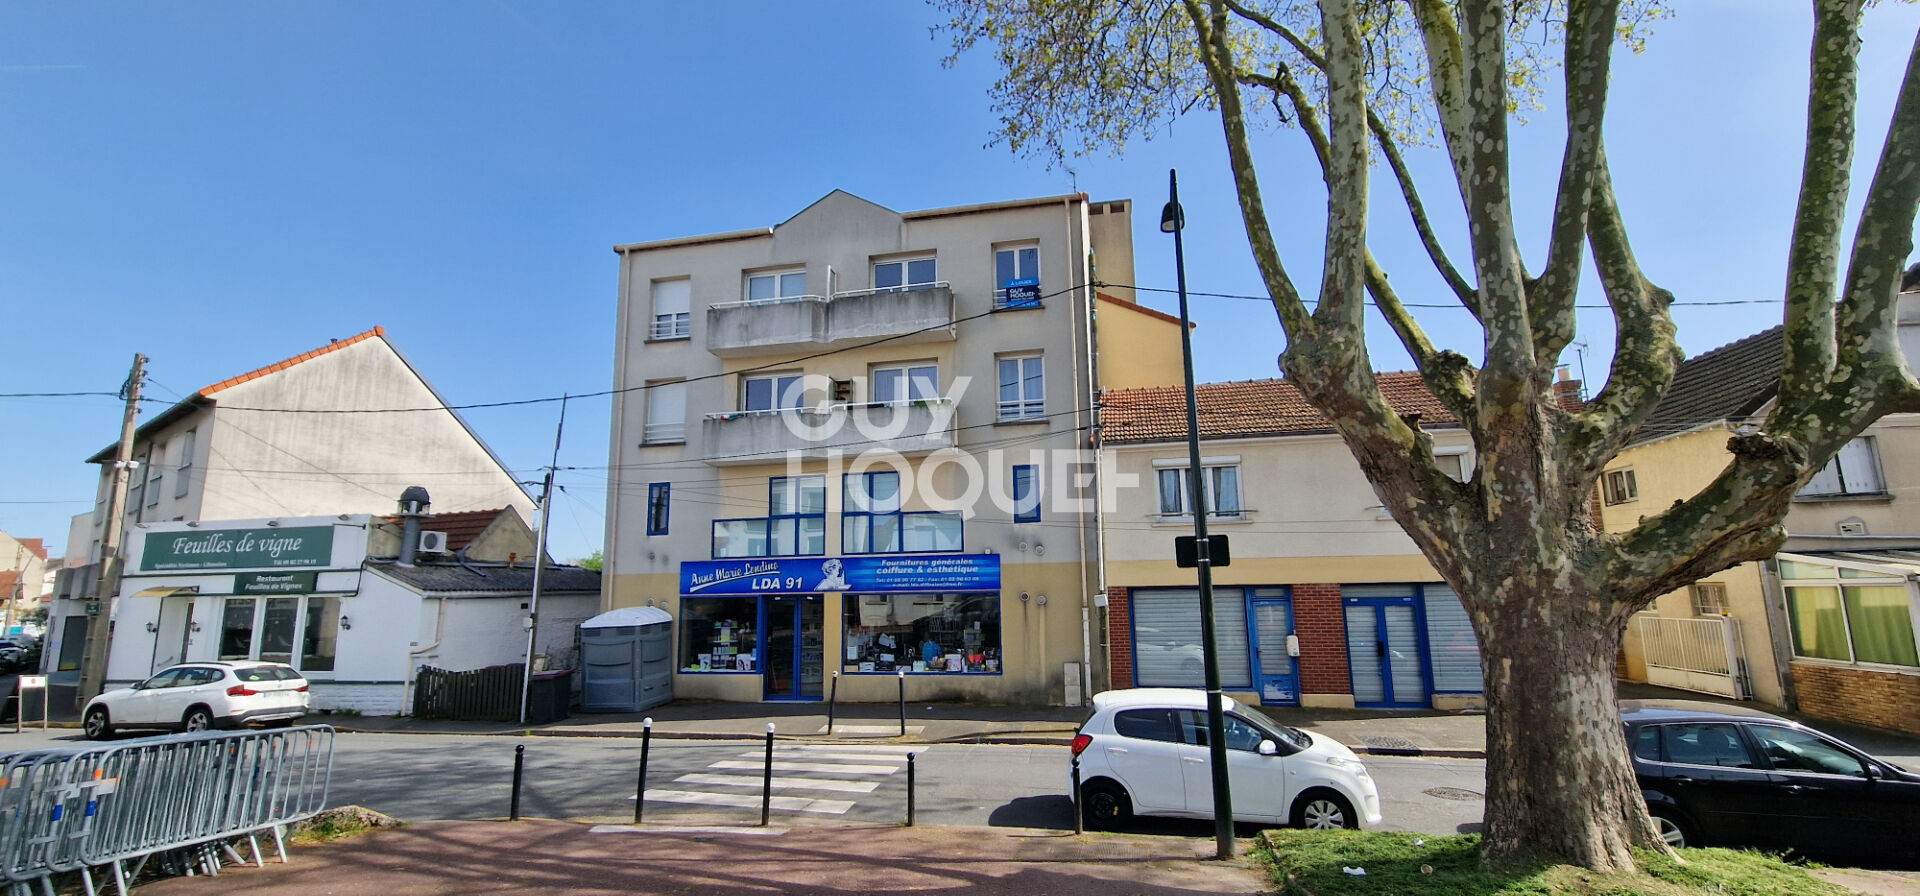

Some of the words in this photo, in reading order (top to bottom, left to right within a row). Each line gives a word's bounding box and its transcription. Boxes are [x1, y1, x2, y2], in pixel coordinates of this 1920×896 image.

[173, 533, 233, 554] Feuilles
[235, 532, 255, 552] de
[259, 533, 302, 558] vigne
[931, 558, 973, 566] générales
[917, 566, 924, 574] &
[926, 564, 979, 574] esthétique
[690, 573, 714, 586] Anne
[716, 567, 743, 581] Marie
[280, 582, 302, 590] Vignes
[752, 577, 781, 590] LDA
[786, 576, 803, 590] 91
